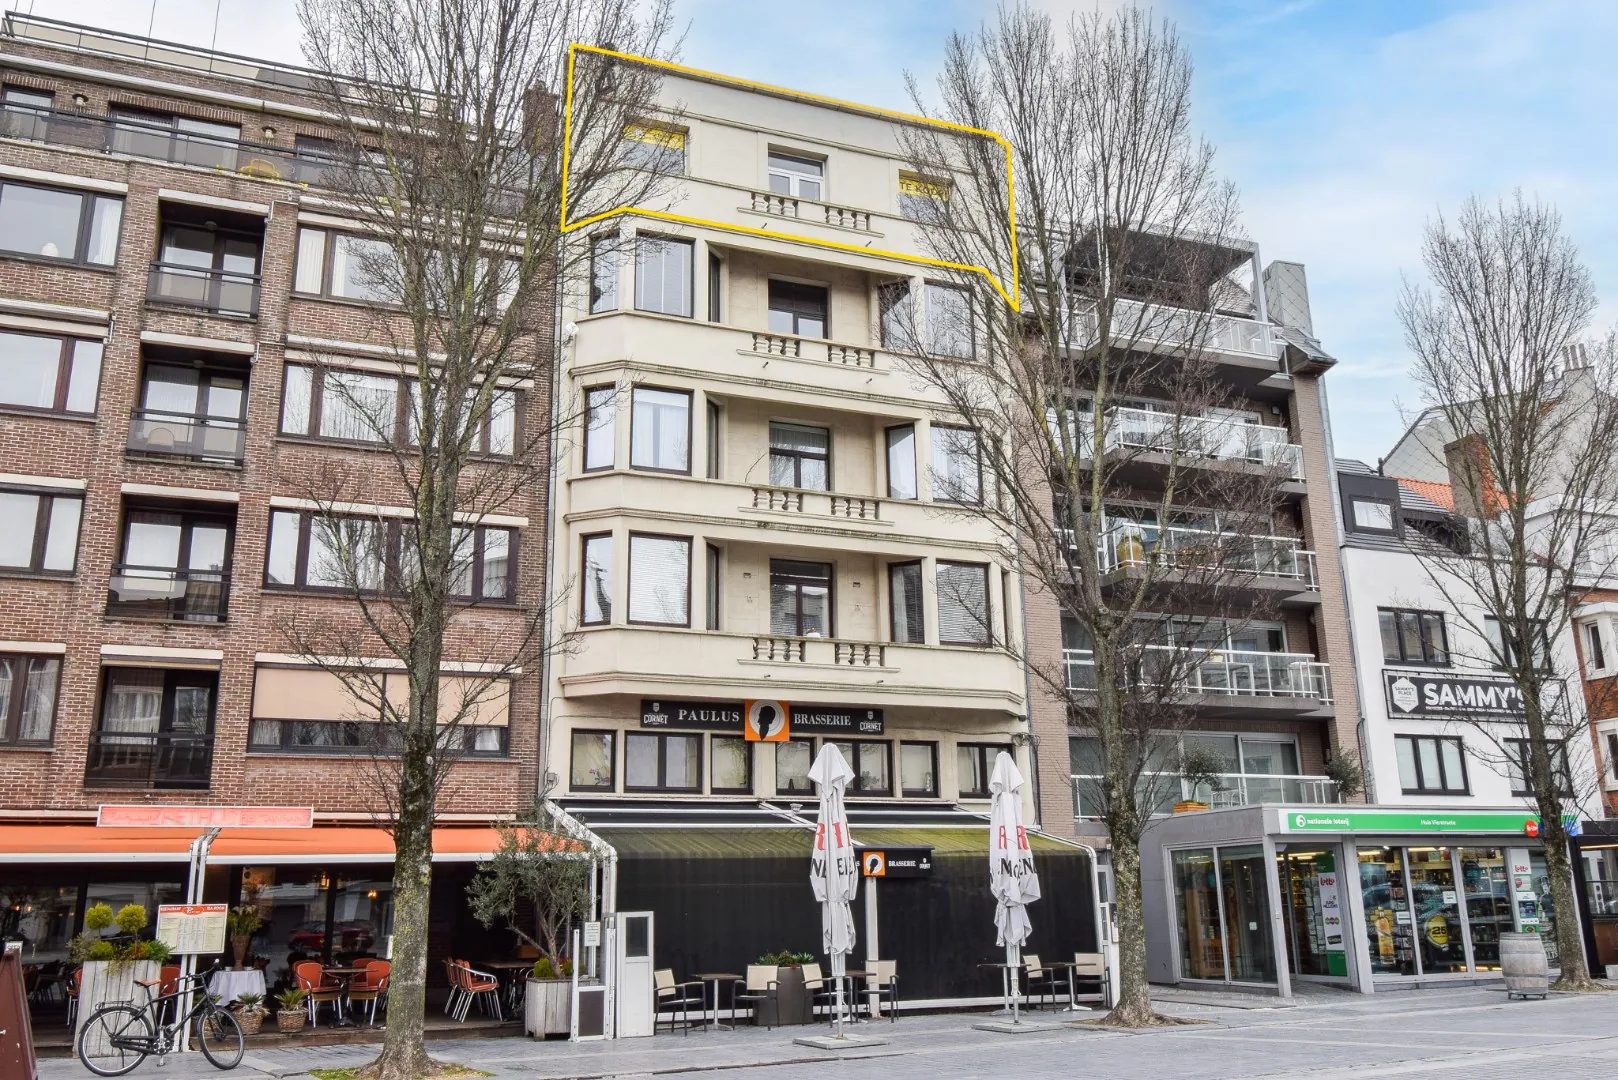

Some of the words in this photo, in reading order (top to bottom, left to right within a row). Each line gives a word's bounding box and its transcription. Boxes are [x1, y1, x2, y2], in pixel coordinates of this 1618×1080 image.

[899, 181, 912, 190] TE
[643, 714, 669, 724] CORNET
[678, 709, 740, 722] PAULUS
[794, 713, 852, 726] BRASSERIE
[859, 721, 882, 732] CORNET
[1514, 864, 1529, 873] lotto
[1320, 877, 1335, 886] lotto
[1432, 926, 1447, 935] 25
